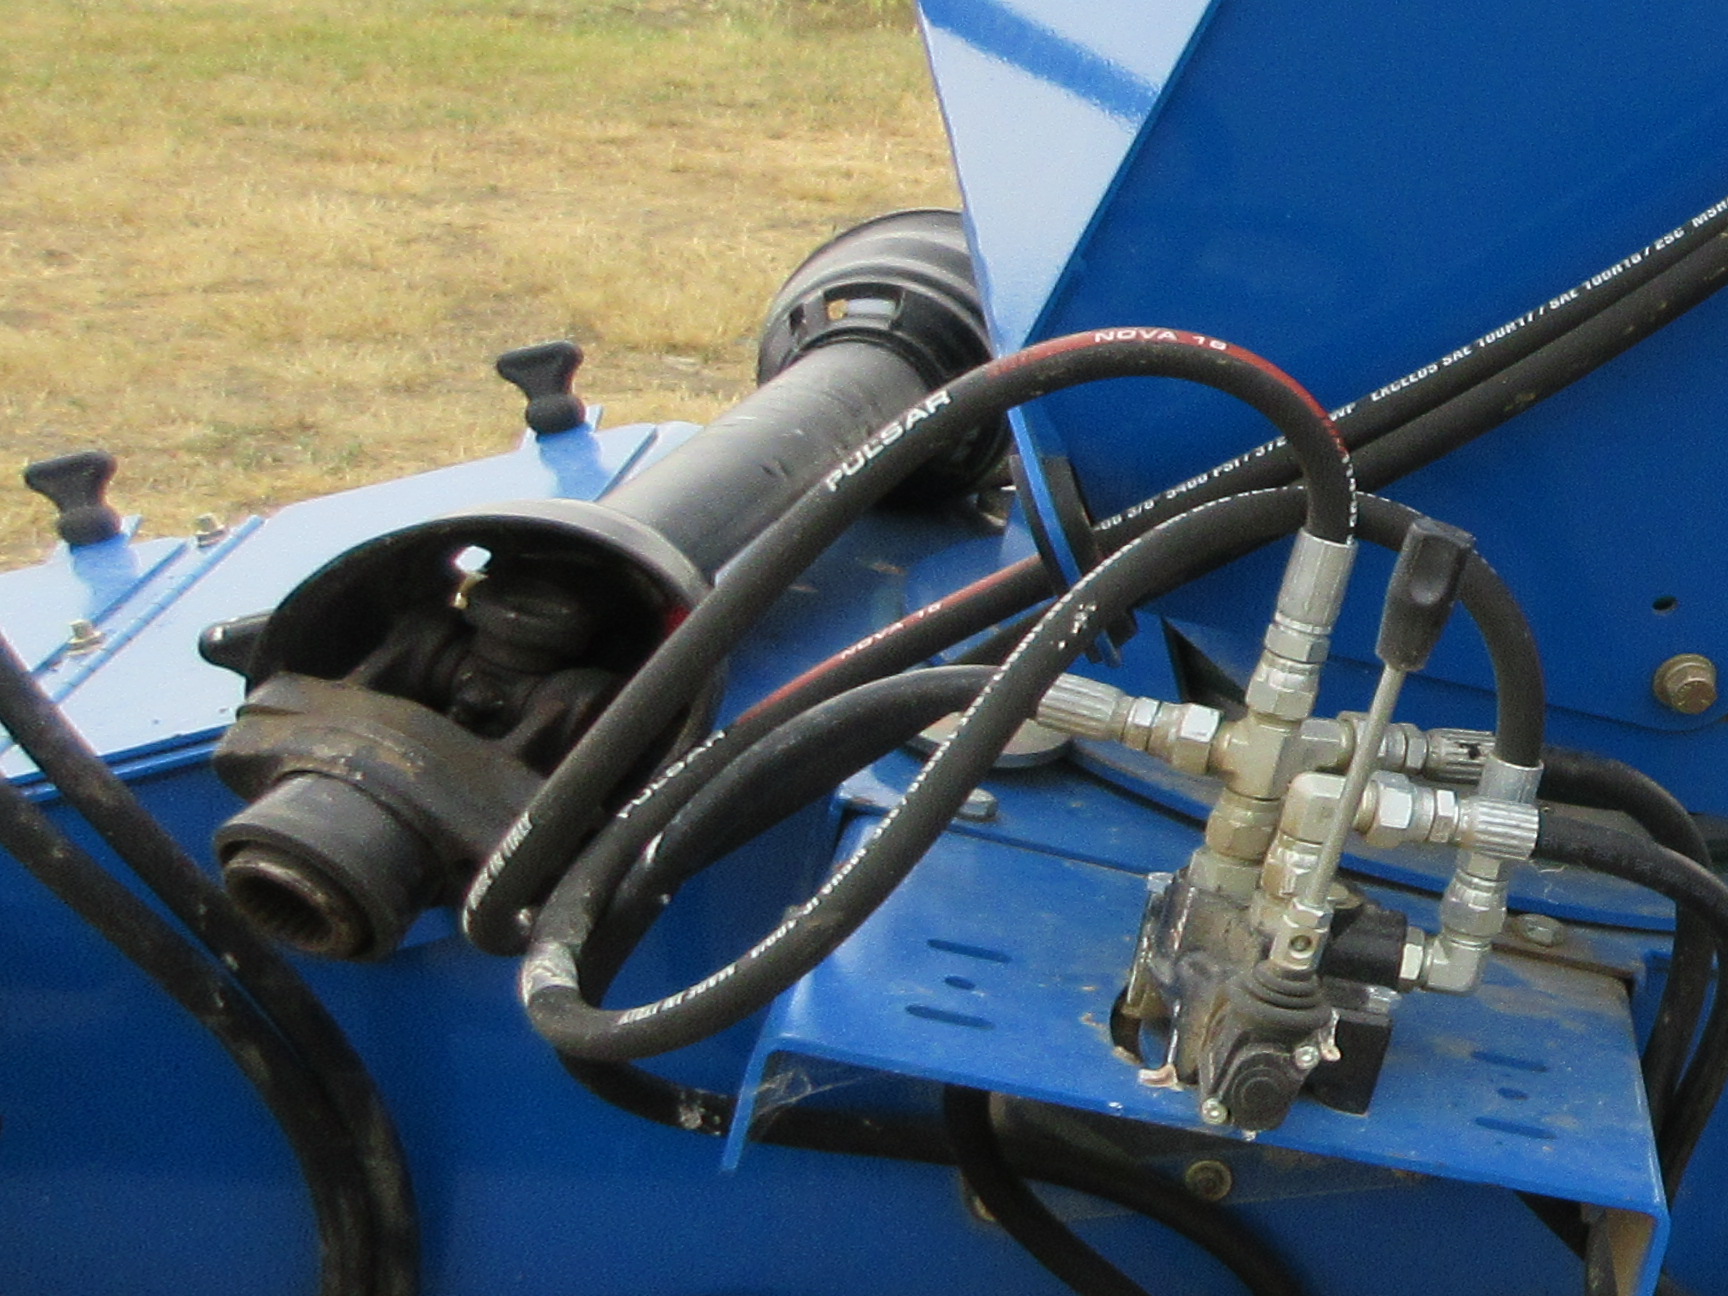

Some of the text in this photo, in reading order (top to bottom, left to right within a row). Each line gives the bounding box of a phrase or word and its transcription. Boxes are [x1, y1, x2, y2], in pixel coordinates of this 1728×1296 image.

[1547, 286, 1580, 311] SAE
[1094, 328, 1178, 343] NOVA
[824, 389, 952, 493] PULSAR
[840, 621, 904, 660] NOVA
